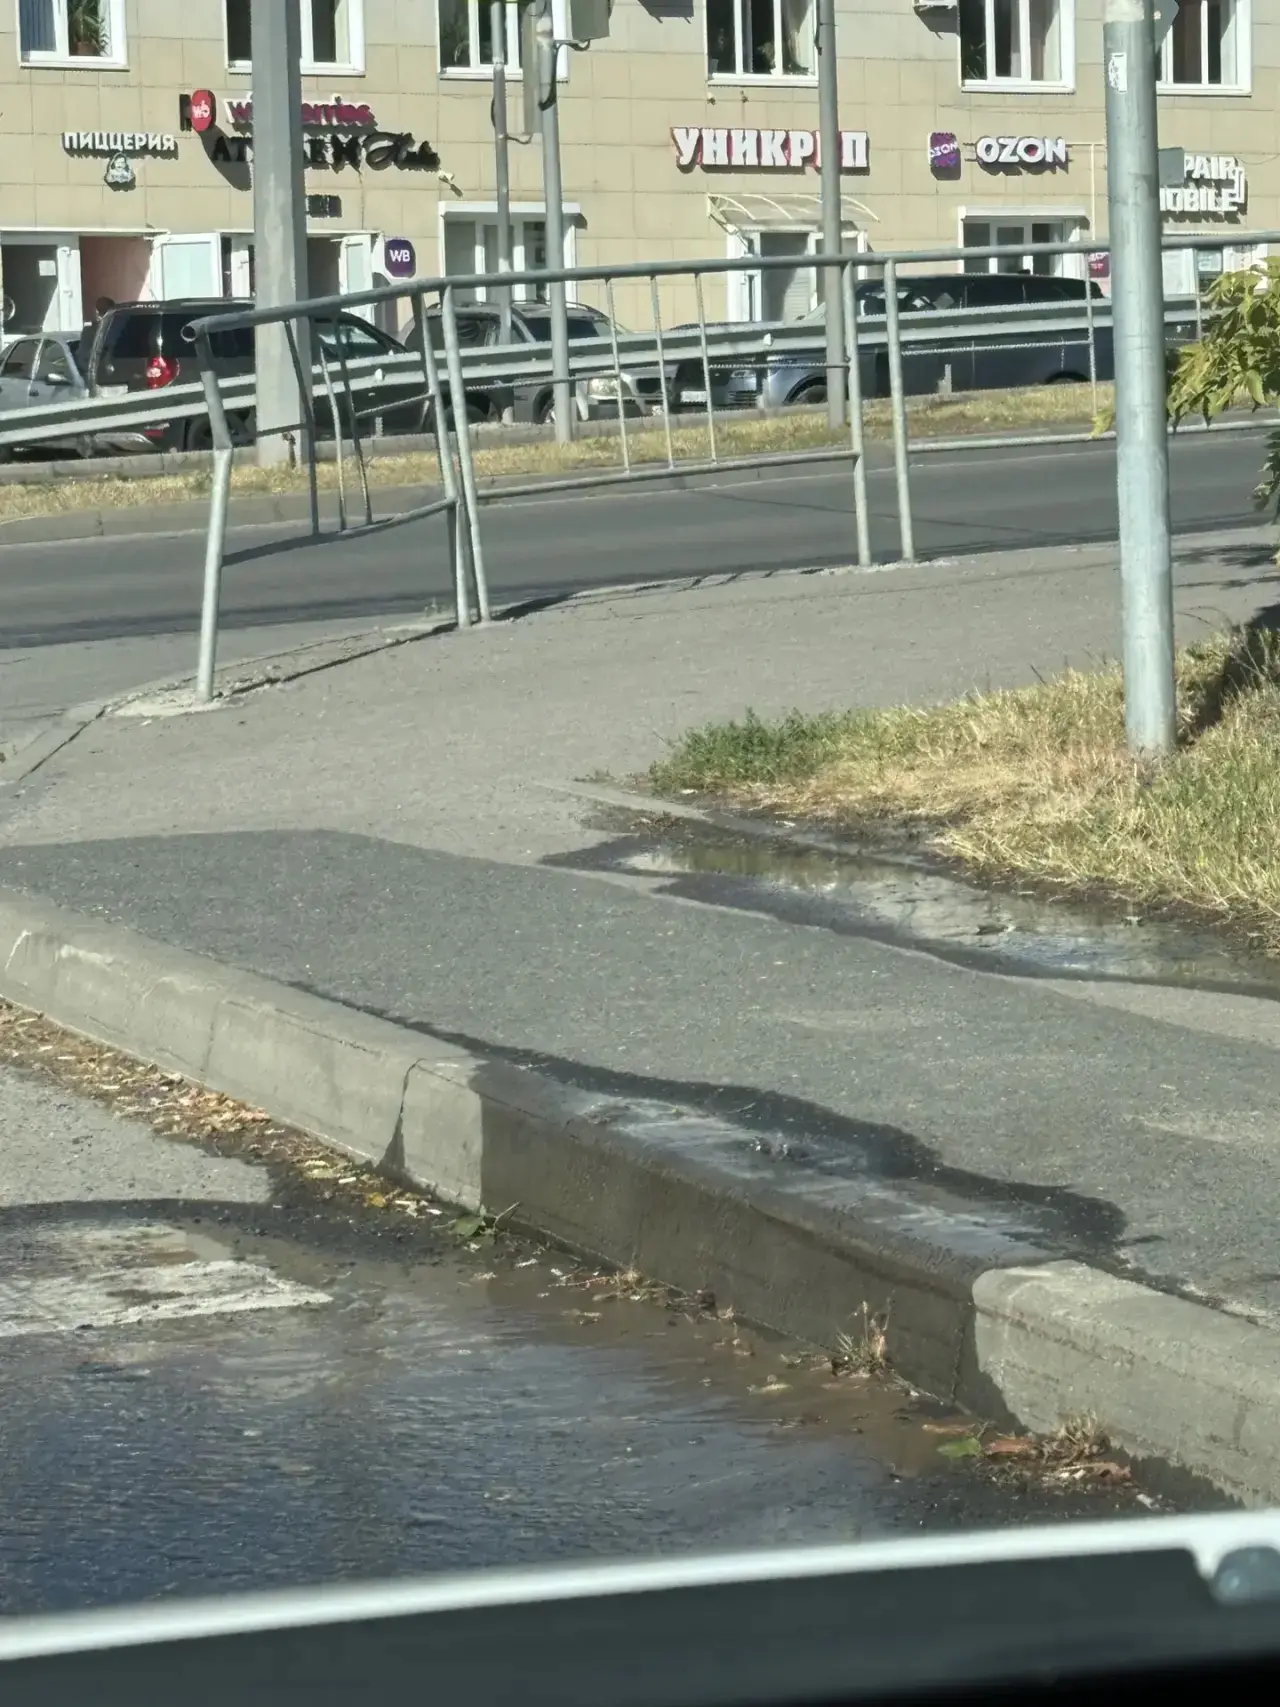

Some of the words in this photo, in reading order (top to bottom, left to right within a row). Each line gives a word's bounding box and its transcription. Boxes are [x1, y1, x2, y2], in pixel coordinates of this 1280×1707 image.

[63, 132, 175, 151] ПИЦЦЕРИЯ
[671, 127, 868, 167] УНИКРП
[976, 136, 1066, 163] OZON
[1184, 153, 1237, 180] PAIR
[1160, 187, 1238, 211] OBILE
[389, 249, 411, 262] WB
